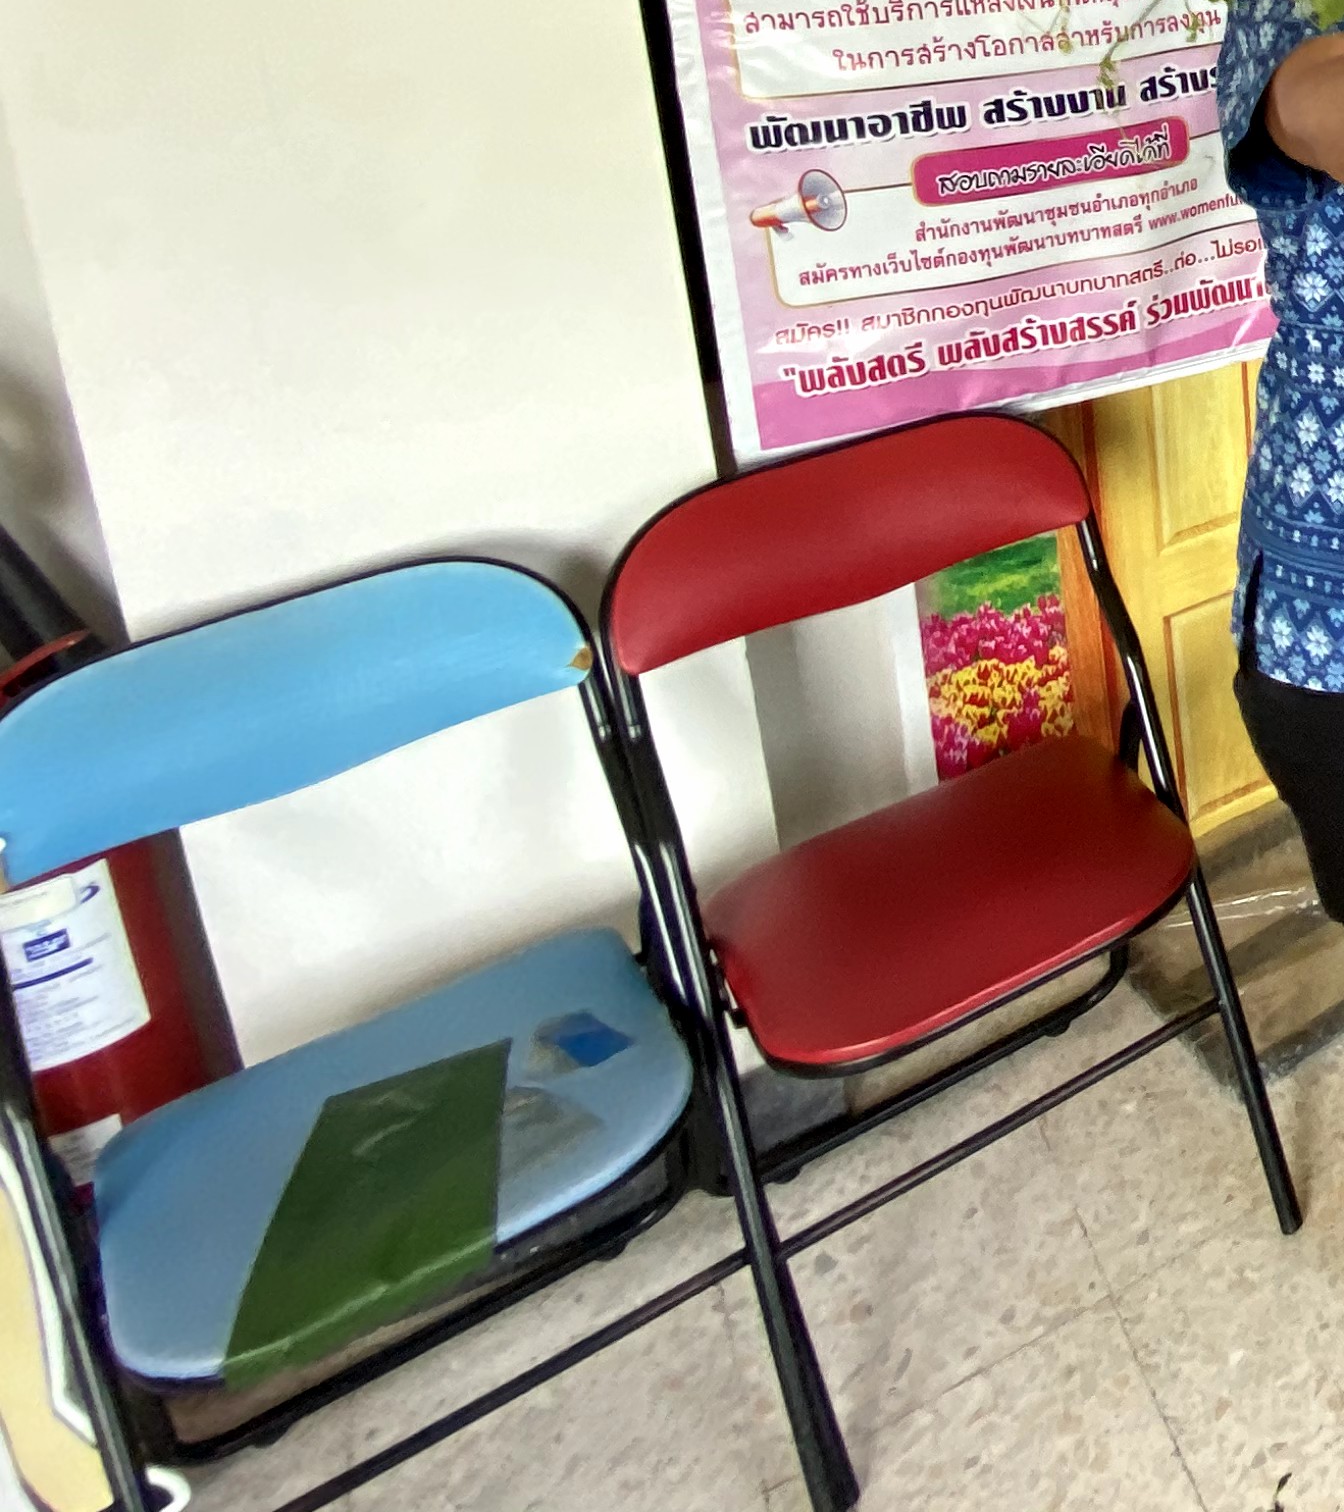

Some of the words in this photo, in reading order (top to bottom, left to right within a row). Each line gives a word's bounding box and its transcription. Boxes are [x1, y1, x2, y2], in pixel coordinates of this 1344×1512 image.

[749, 102, 967, 150] พัฒนาอาชีพ
[984, 84, 1127, 125] สร้างงาน
[938, 300, 1137, 366] พลังสร้างสรรค์
